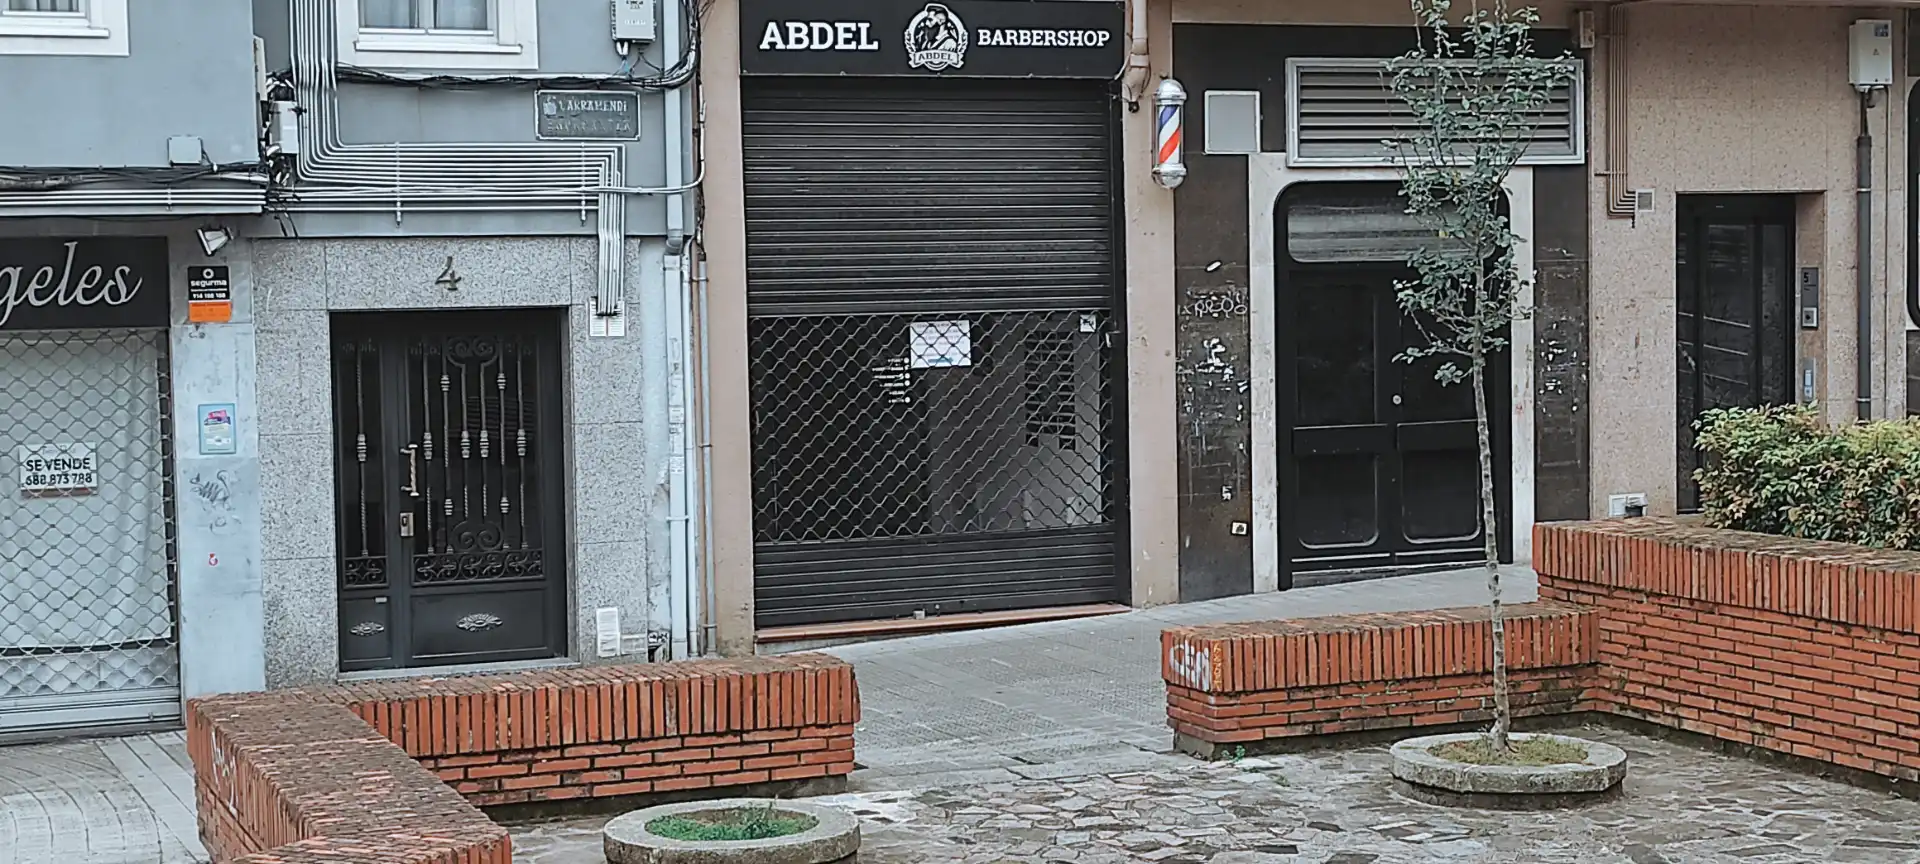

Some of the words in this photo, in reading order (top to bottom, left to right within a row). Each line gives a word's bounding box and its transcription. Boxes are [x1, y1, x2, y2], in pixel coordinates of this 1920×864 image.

[759, 22, 879, 50] ABDEL
[977, 29, 1111, 48] BARBERSHOP
[918, 52, 954, 62] ABDEL
[434, 255, 463, 291] 4
[1803, 272, 1809, 283] 5
[26, 459, 43, 473] SE
[45, 456, 92, 472] VENDE
[49, 471, 70, 486] 873
